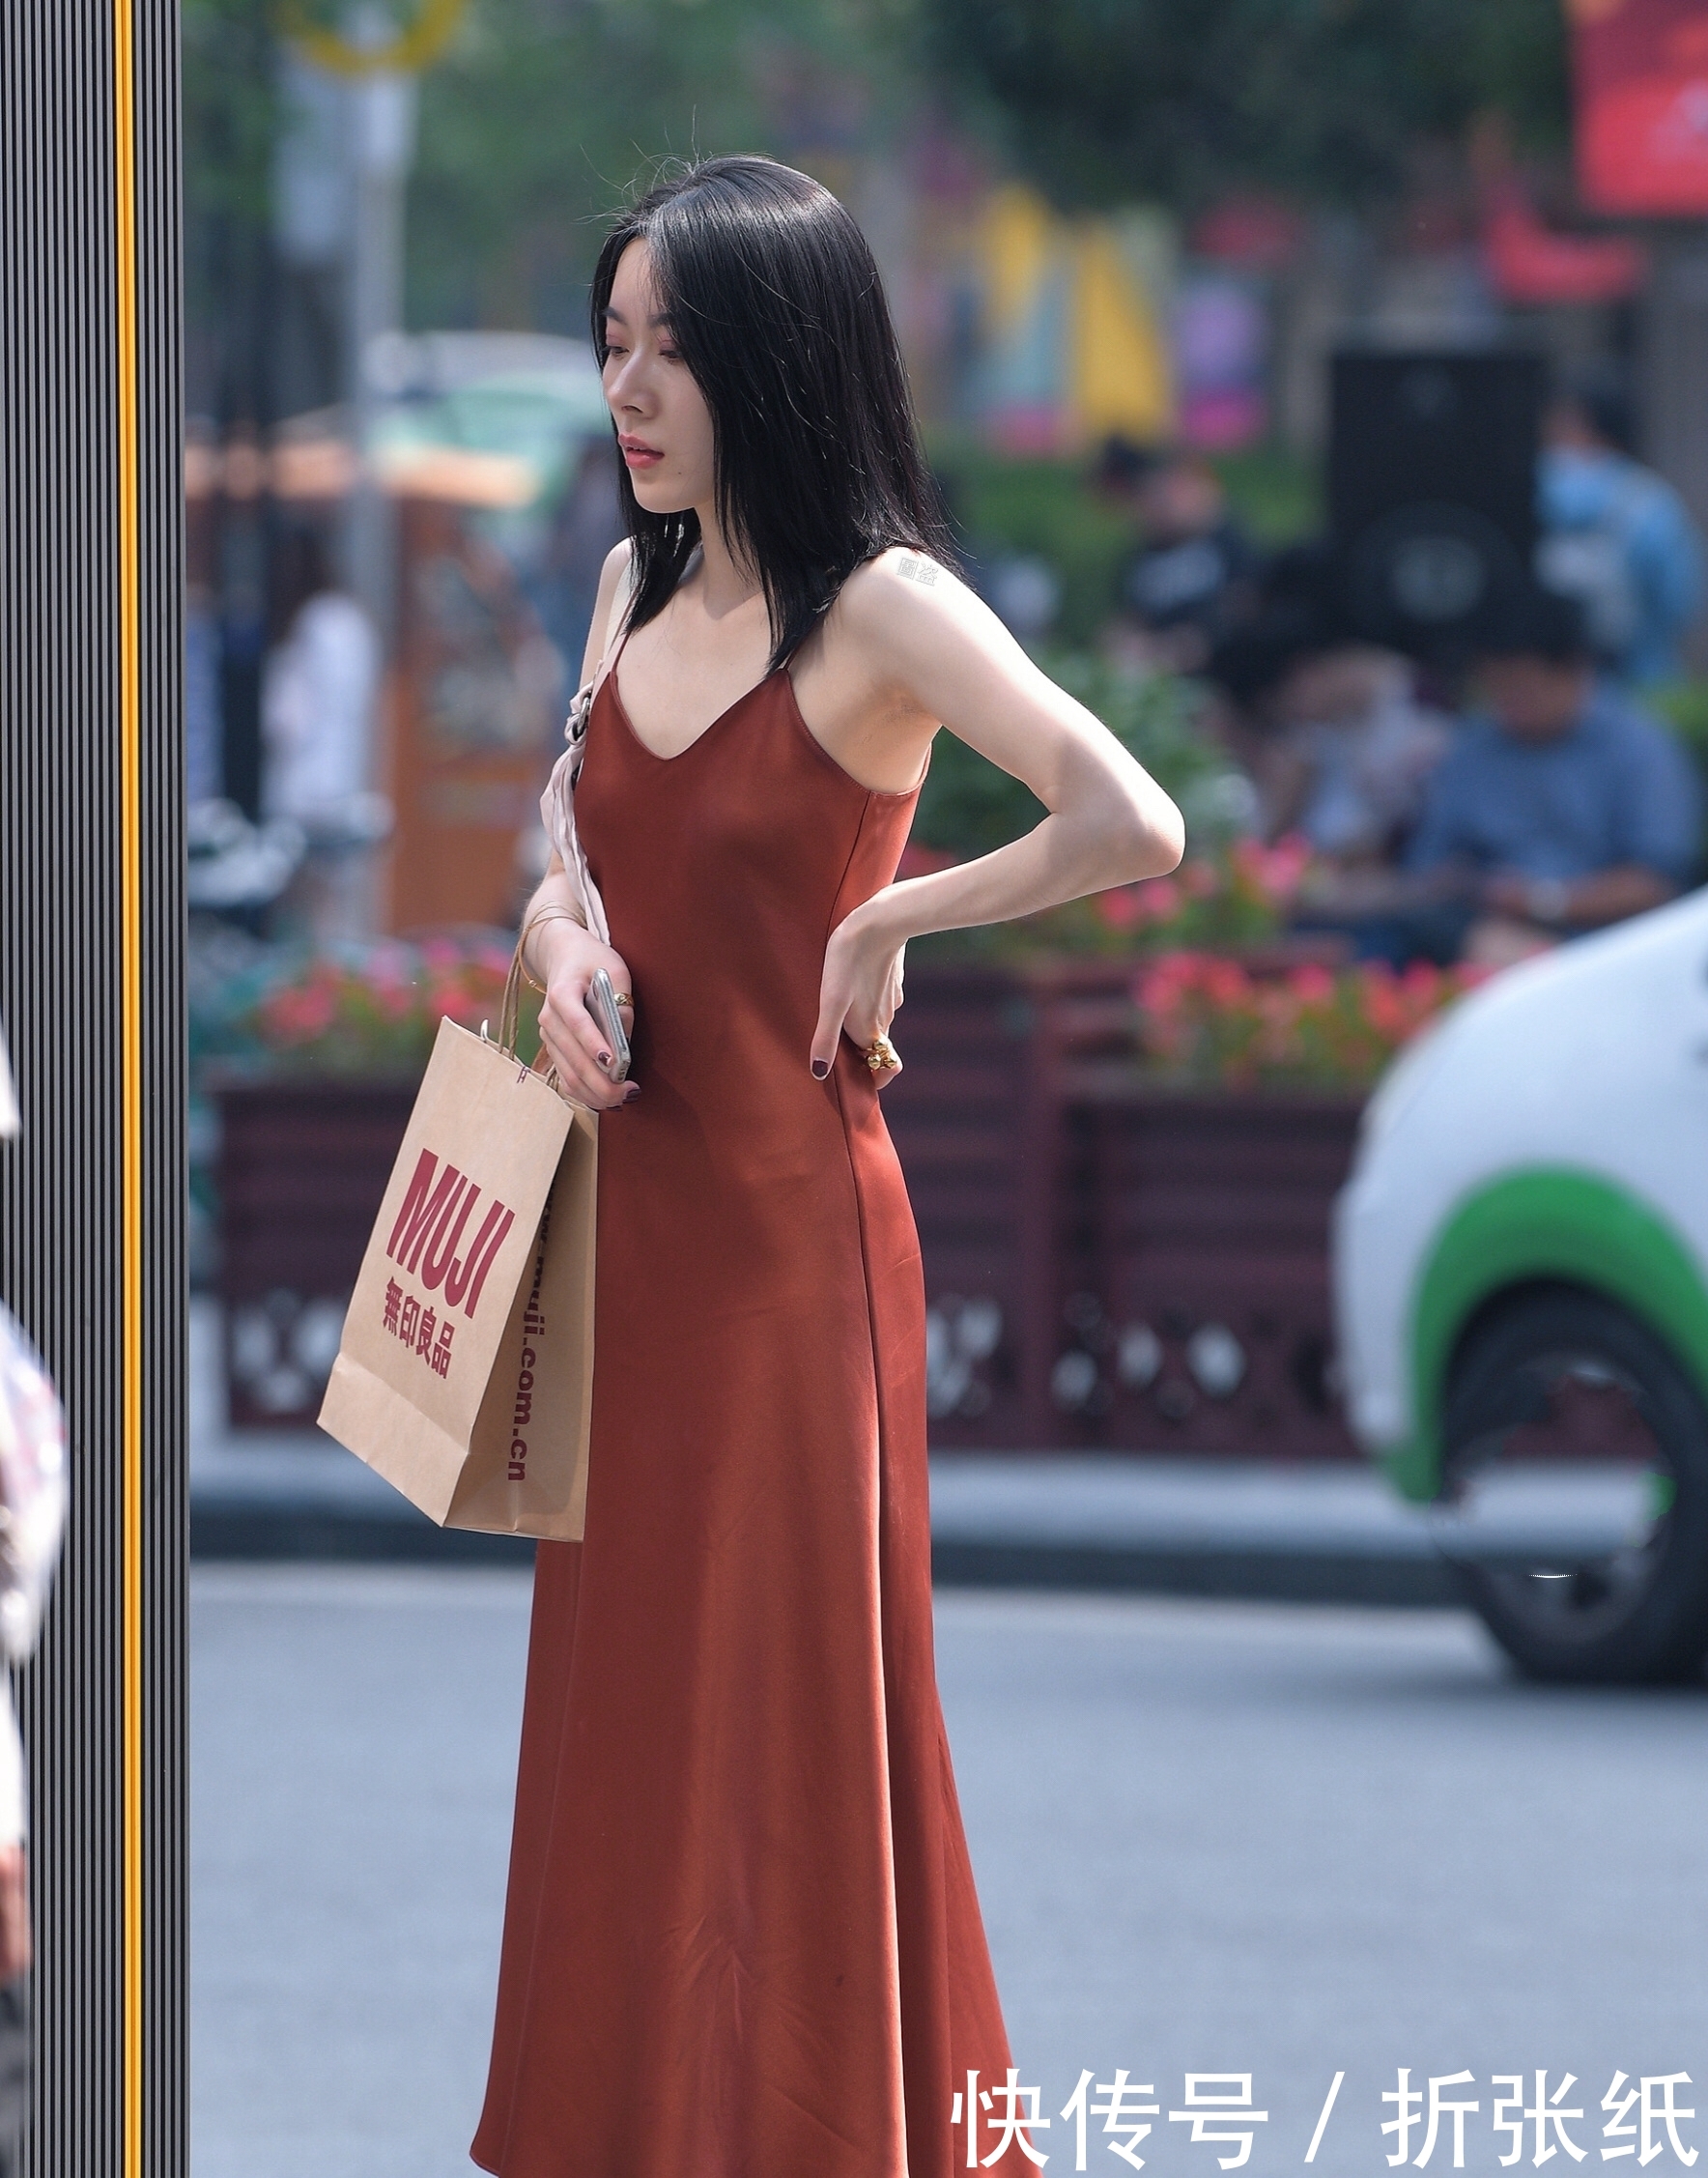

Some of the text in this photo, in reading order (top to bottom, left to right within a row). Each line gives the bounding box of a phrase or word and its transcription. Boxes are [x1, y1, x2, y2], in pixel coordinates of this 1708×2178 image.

[385, 1147, 515, 1320] MUJI
[383, 1275, 456, 1380] 無印良品
